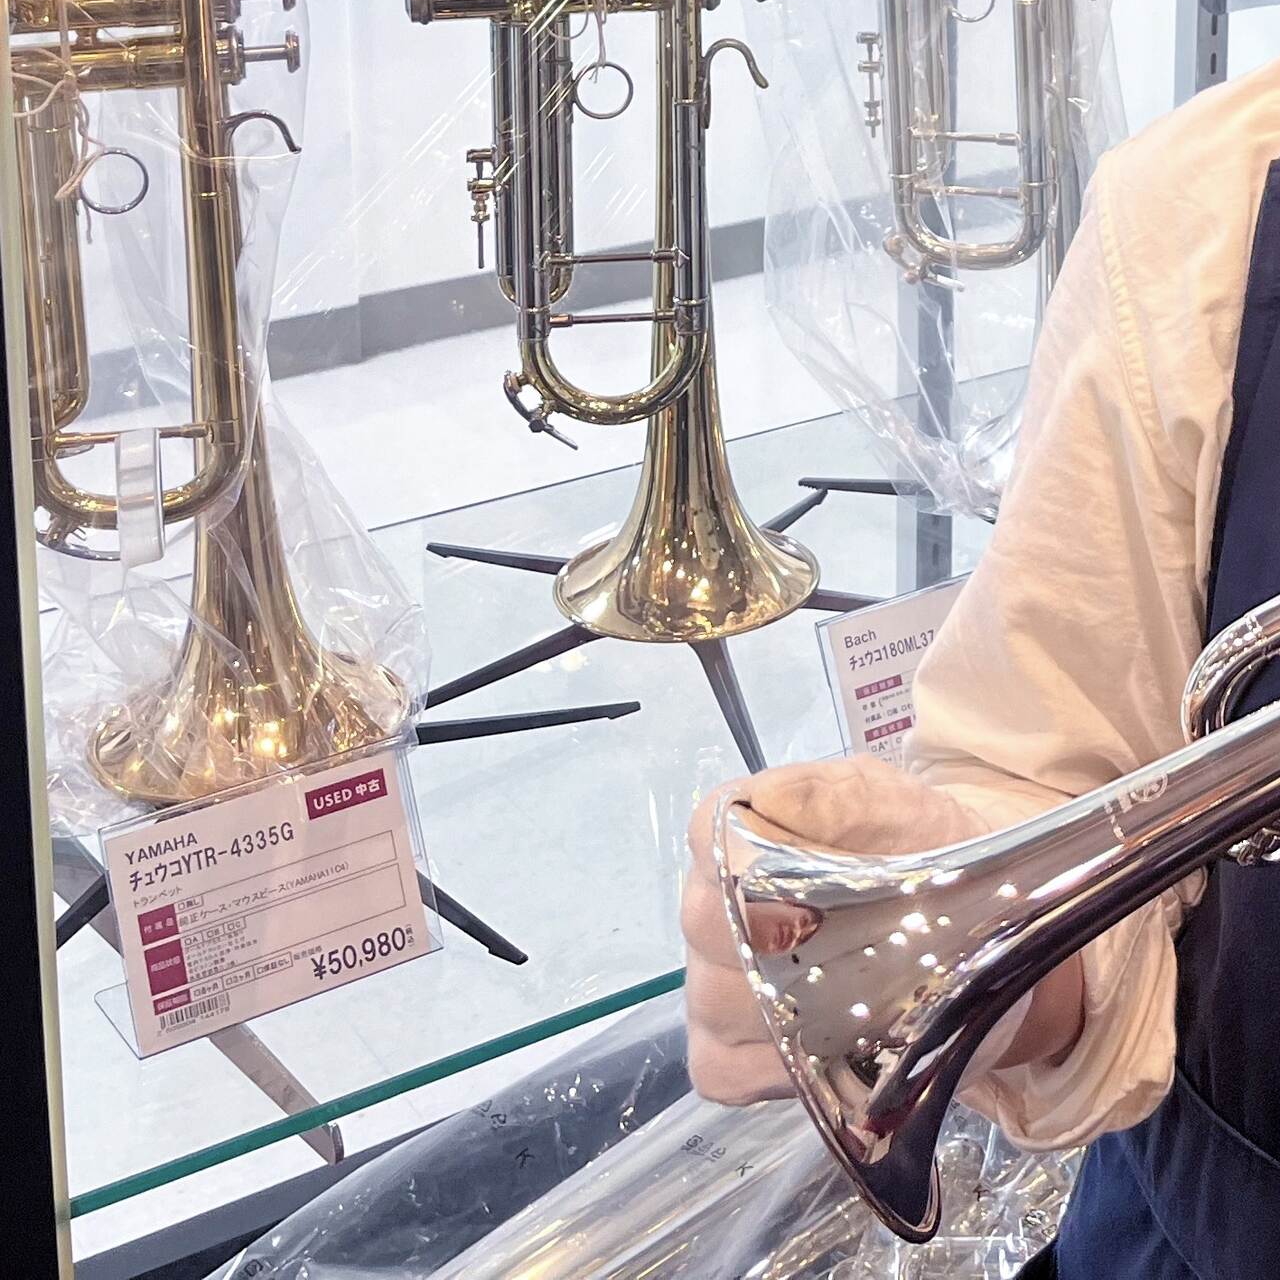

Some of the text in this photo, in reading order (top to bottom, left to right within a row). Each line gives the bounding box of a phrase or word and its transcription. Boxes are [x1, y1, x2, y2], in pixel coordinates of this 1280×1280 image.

[844, 629, 877, 649] Bach
[313, 778, 381, 812] USED 中古
[124, 831, 199, 866] YAMAHA
[129, 821, 295, 892] チュウコYTR-4335G
[132, 885, 183, 909] トランペット
[310, 926, 406, 980] ¥50,980
